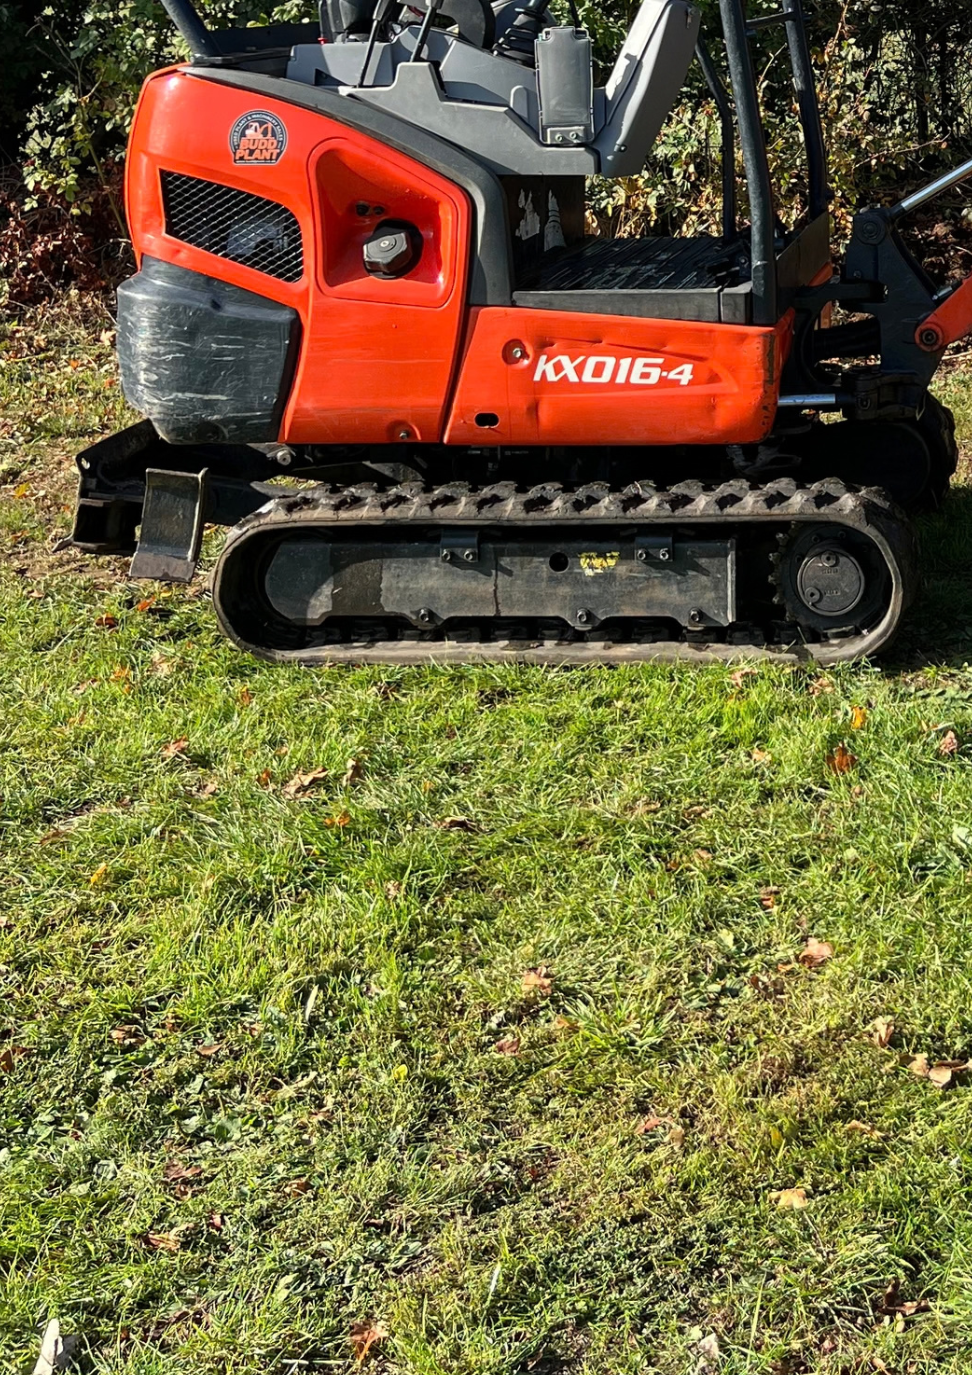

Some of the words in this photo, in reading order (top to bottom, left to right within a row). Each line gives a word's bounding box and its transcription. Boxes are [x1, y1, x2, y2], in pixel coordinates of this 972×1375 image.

[239, 139, 278, 149] BUDD
[235, 149, 280, 160] PLANT
[533, 355, 694, 385] KX016-4
